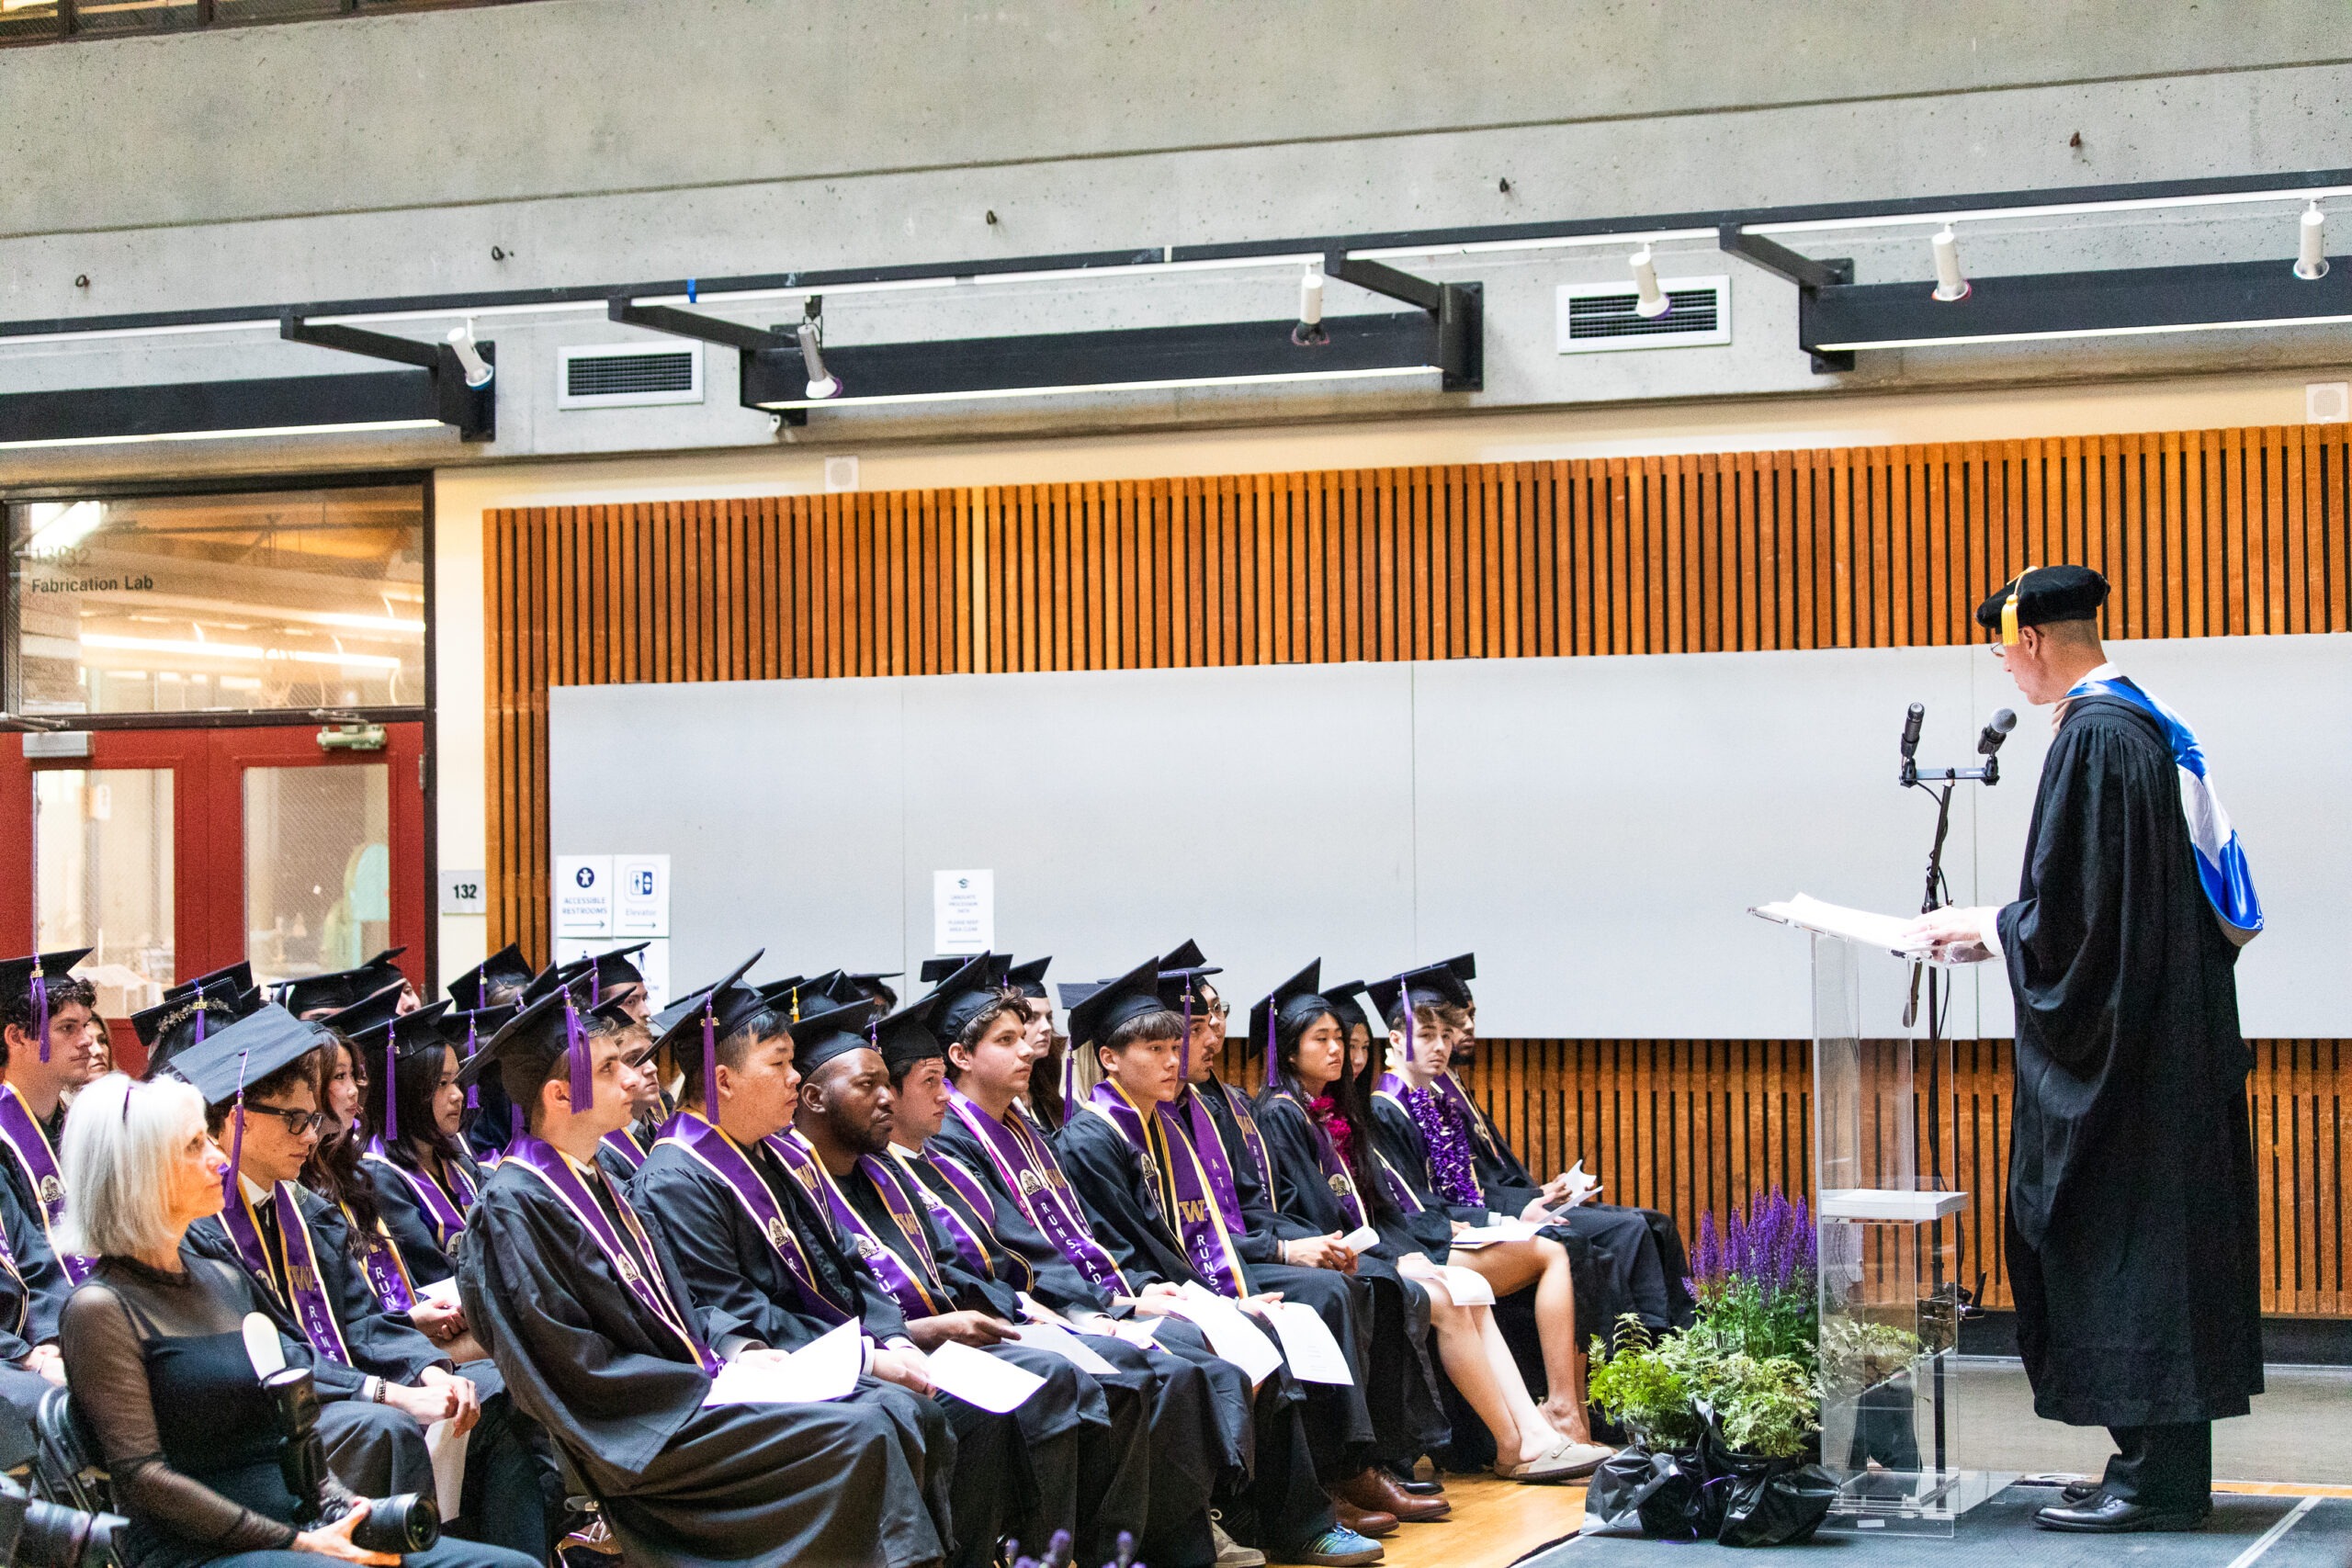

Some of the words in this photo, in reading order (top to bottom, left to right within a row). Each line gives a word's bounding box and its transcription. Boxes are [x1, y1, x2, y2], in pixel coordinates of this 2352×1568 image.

[32, 576, 118, 592] Fabrication
[124, 575, 153, 591] Lab
[452, 884, 478, 899] 132
[564, 897, 606, 905] ACCESSIBLE
[562, 907, 607, 915] RESTROOMS
[1178, 1199, 1205, 1224] W
[1040, 1201, 1102, 1286] RUNSTAD
